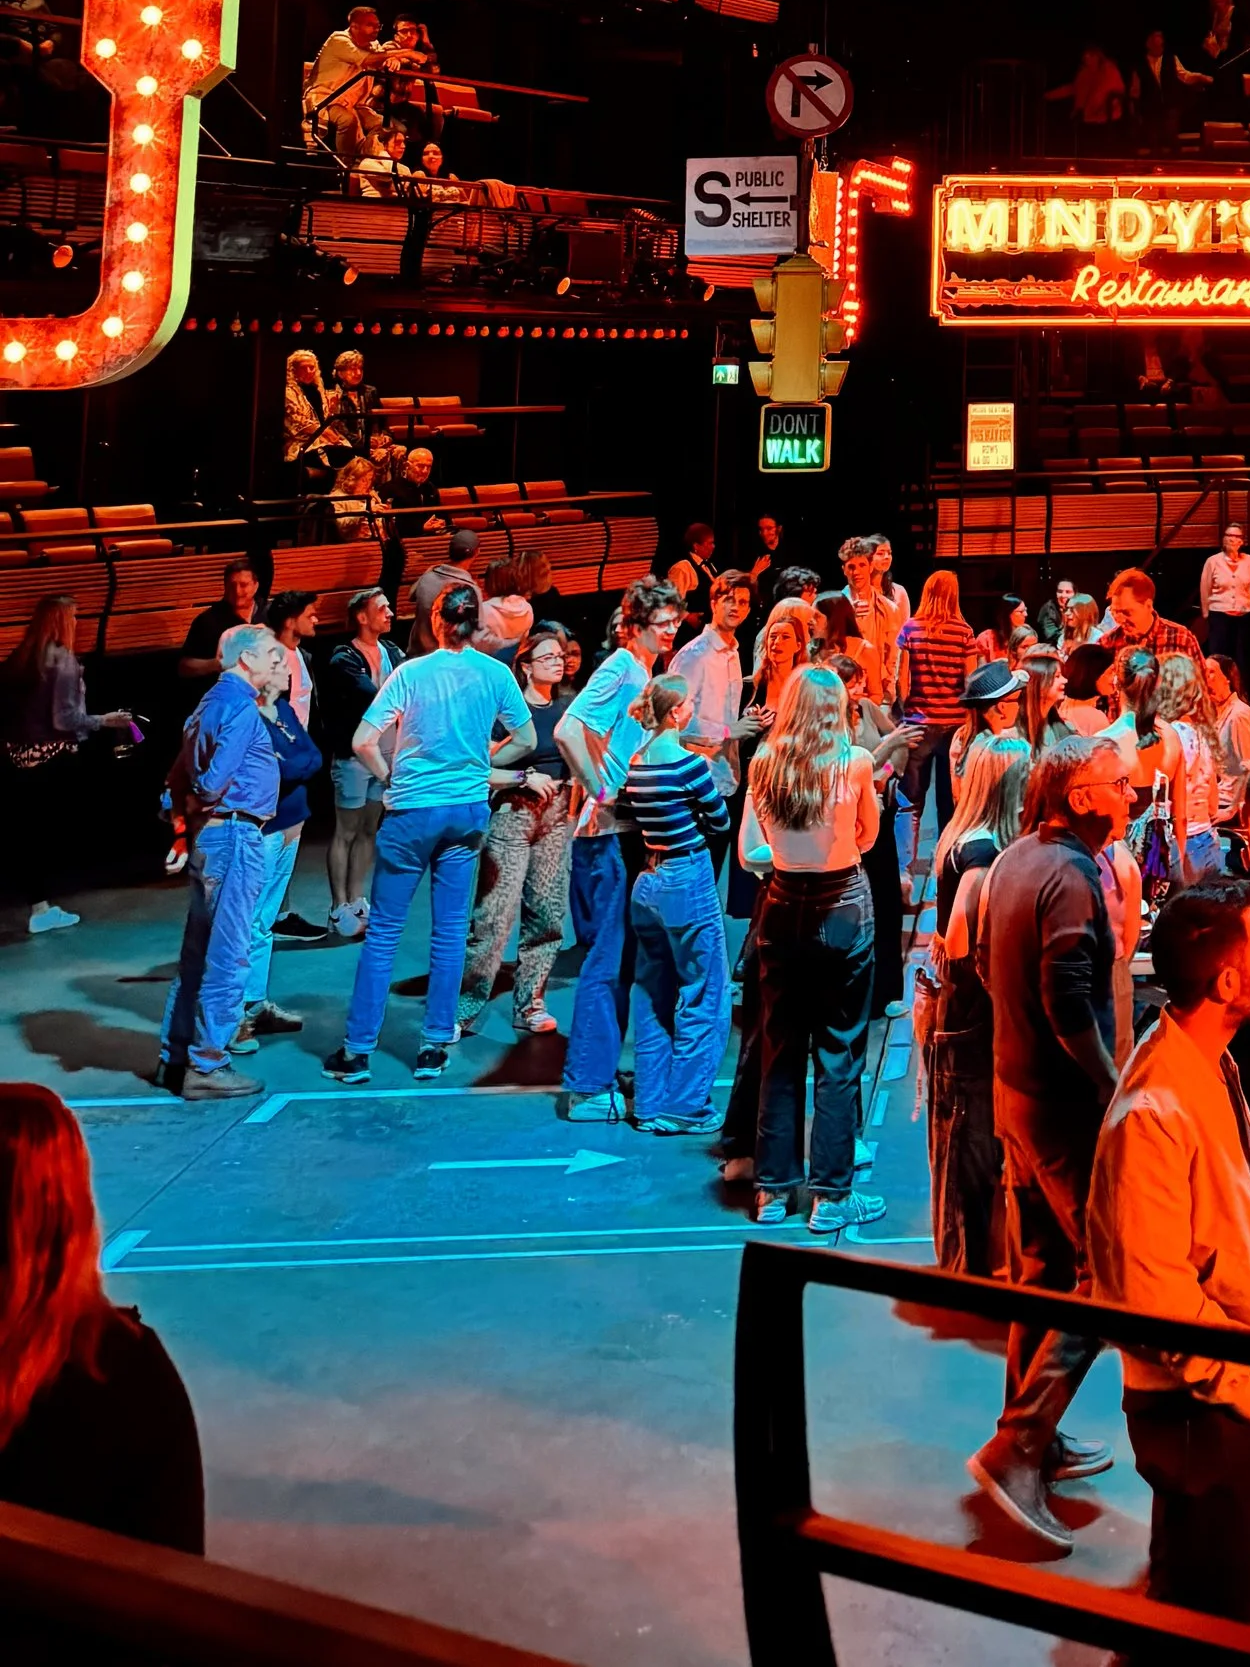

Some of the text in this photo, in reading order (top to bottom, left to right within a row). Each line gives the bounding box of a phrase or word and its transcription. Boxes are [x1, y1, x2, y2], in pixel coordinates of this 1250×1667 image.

[735, 171, 785, 187] PUBLIC
[694, 170, 731, 228] S
[732, 210, 792, 228] SHELTER
[769, 414, 821, 435] DONT
[765, 438, 821, 464] WALK
